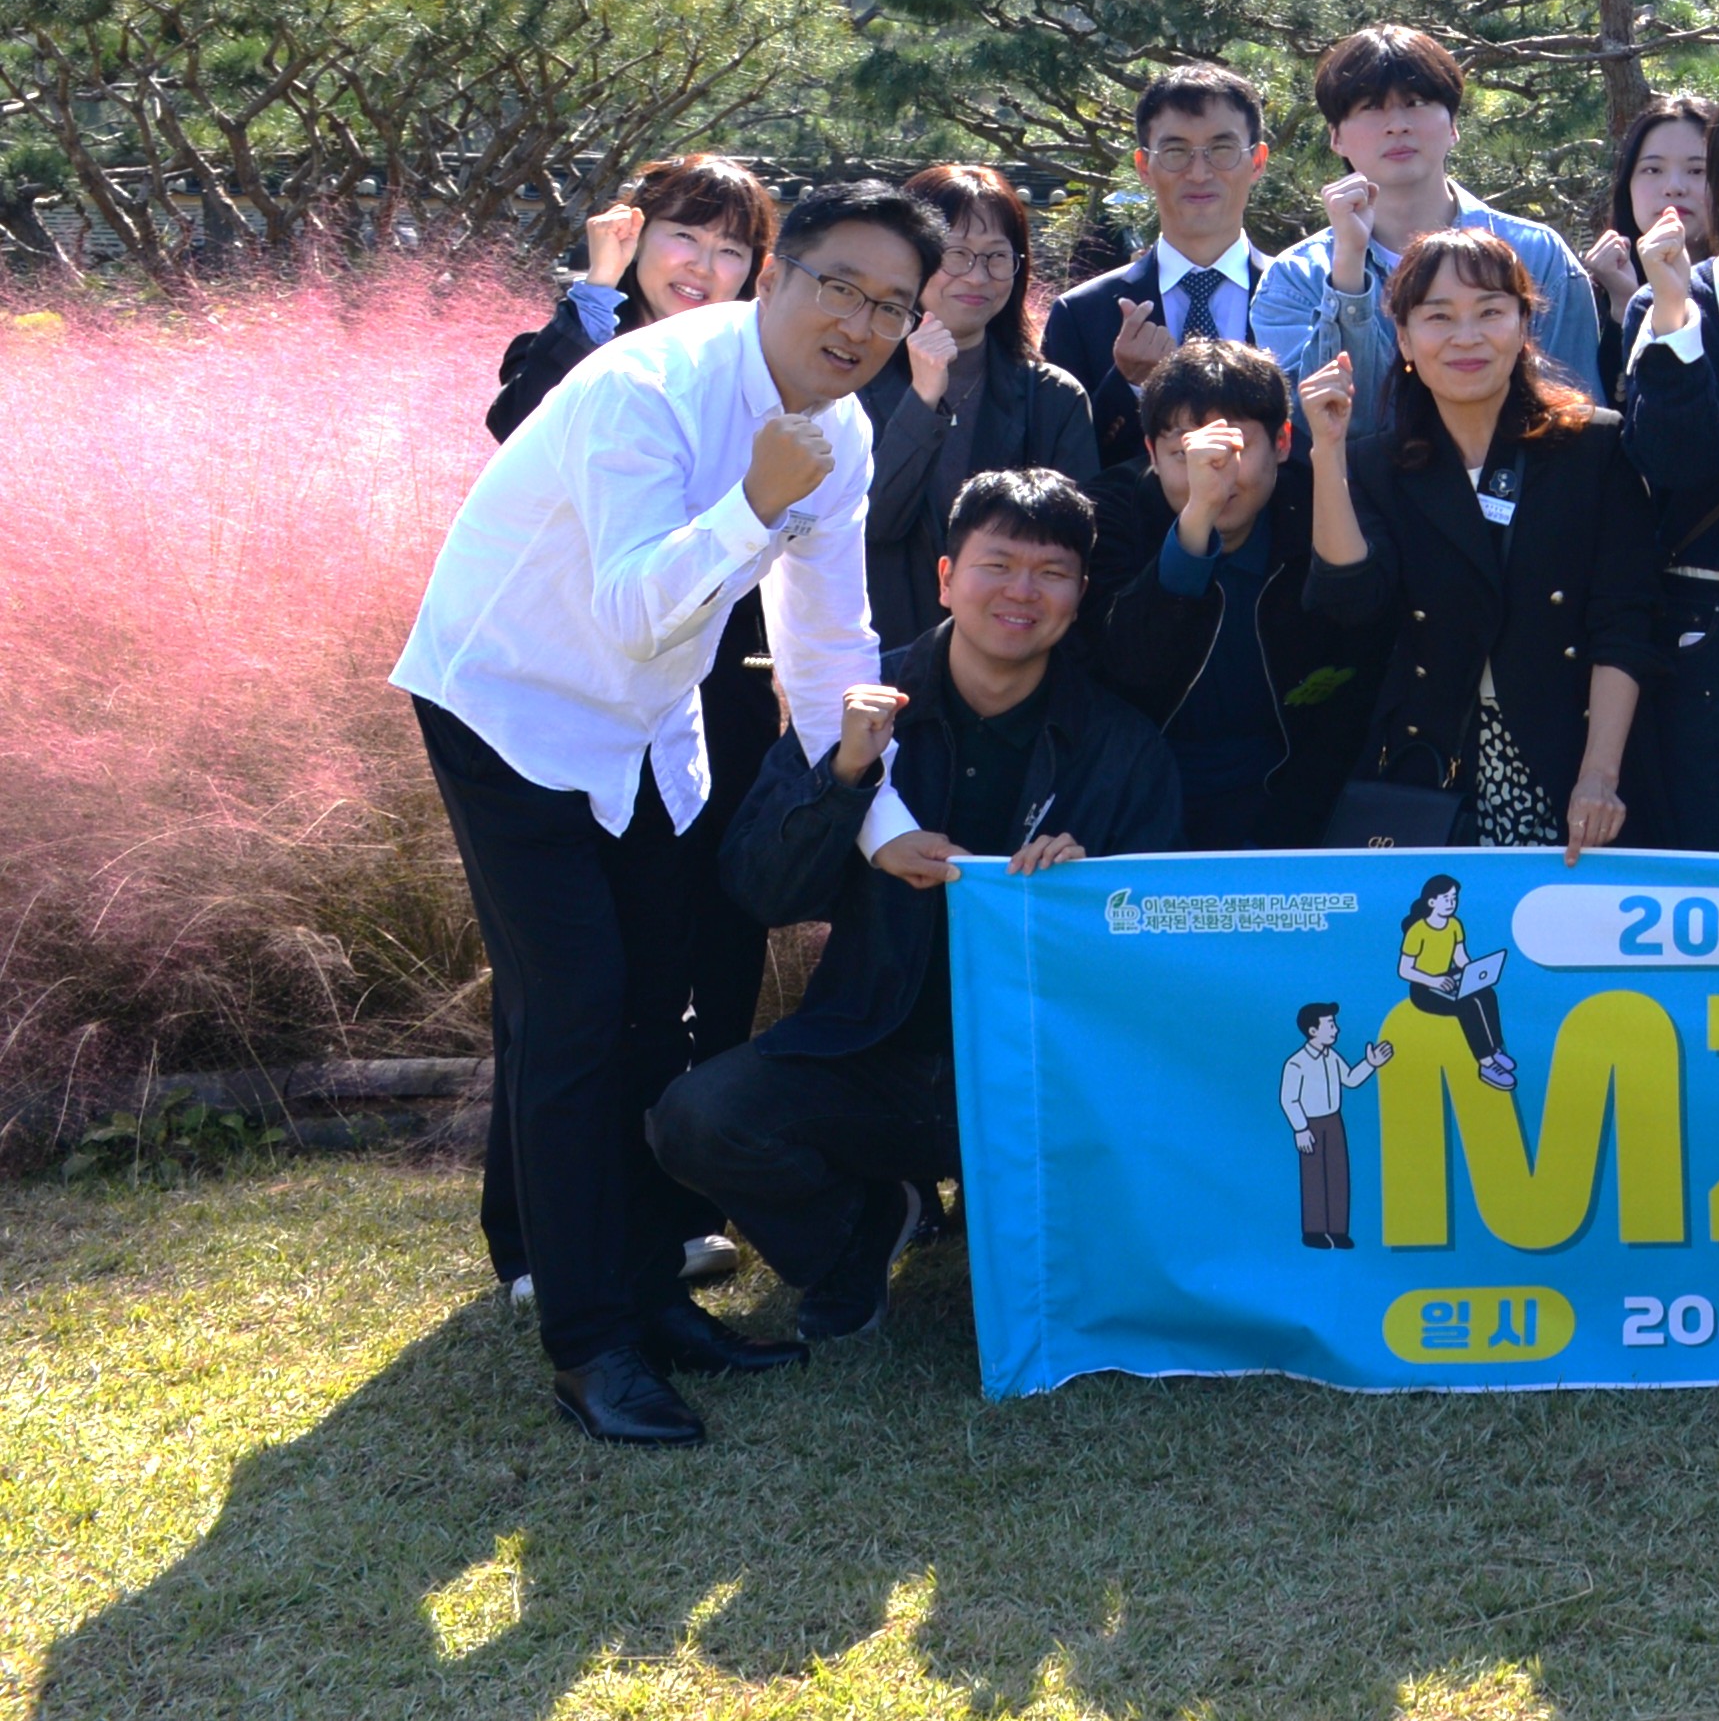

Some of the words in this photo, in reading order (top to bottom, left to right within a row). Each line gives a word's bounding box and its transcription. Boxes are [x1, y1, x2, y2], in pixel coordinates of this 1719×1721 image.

[1144, 898, 1160, 912] 이
[1163, 896, 1218, 913] 현수막은
[1223, 896, 1266, 912] 생분해
[1270, 895, 1356, 912] PLA원단으로
[1112, 910, 1136, 919] BIO
[1144, 914, 1188, 930] 제작된
[1192, 914, 1234, 929] 친환경
[1238, 913, 1328, 929] 현수막입니다.
